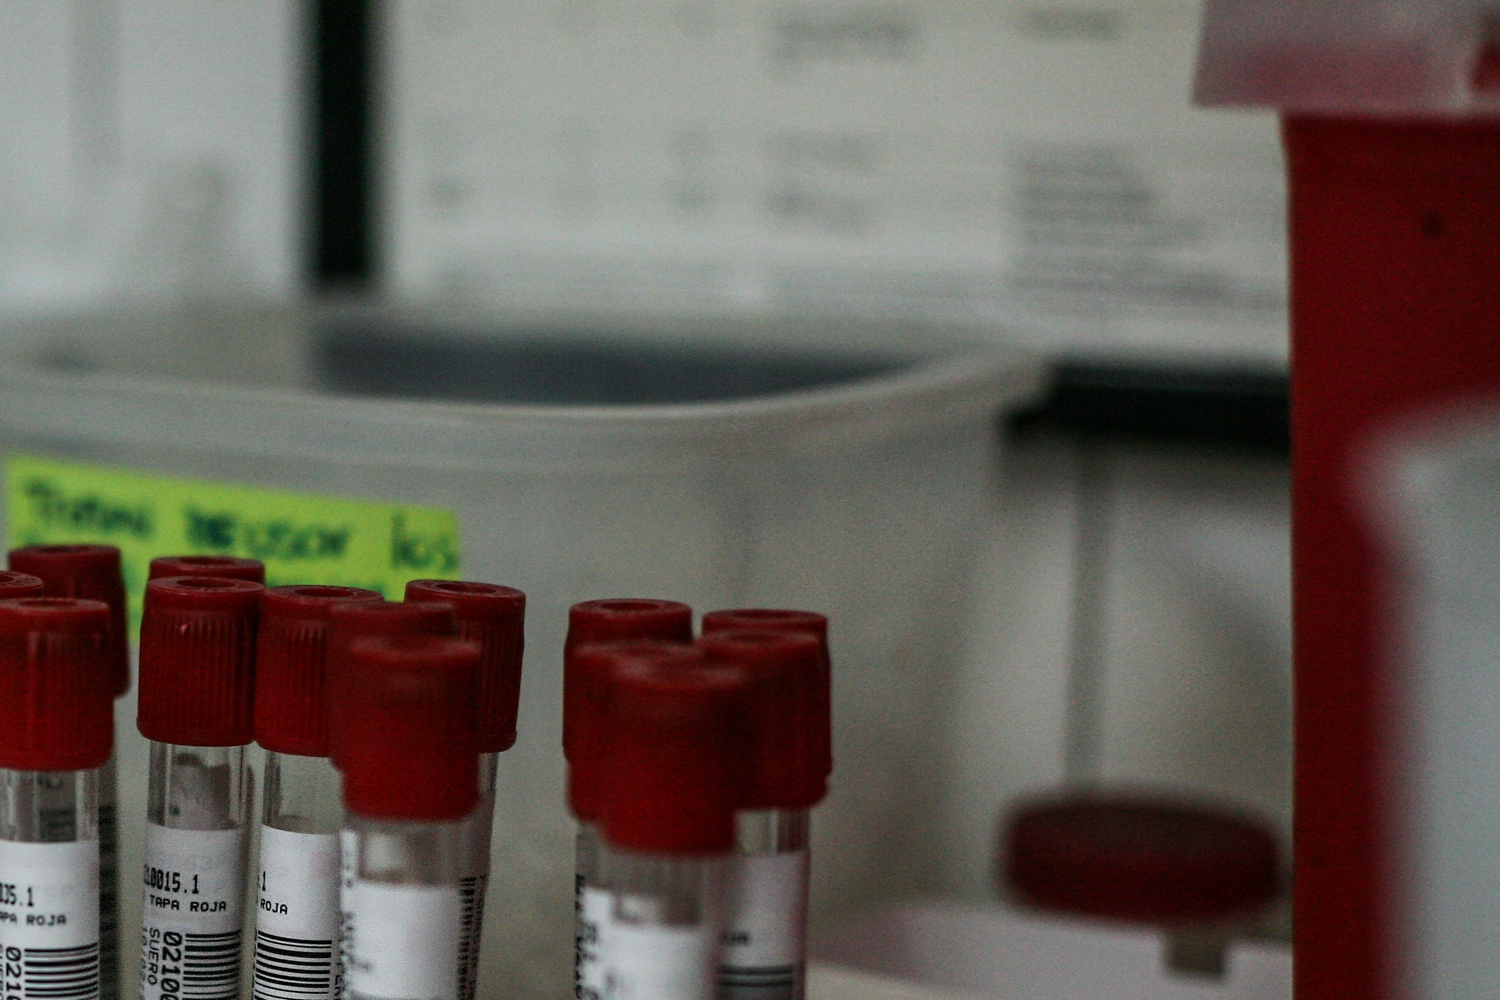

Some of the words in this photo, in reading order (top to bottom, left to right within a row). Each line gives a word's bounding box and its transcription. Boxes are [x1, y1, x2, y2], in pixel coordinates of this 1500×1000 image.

[149, 894, 180, 911] TAPA
[190, 900, 227, 912] ROJA
[260, 898, 288, 915] ROJA
[26, 913, 68, 926] ROJA
[147, 927, 161, 986] SUERO
